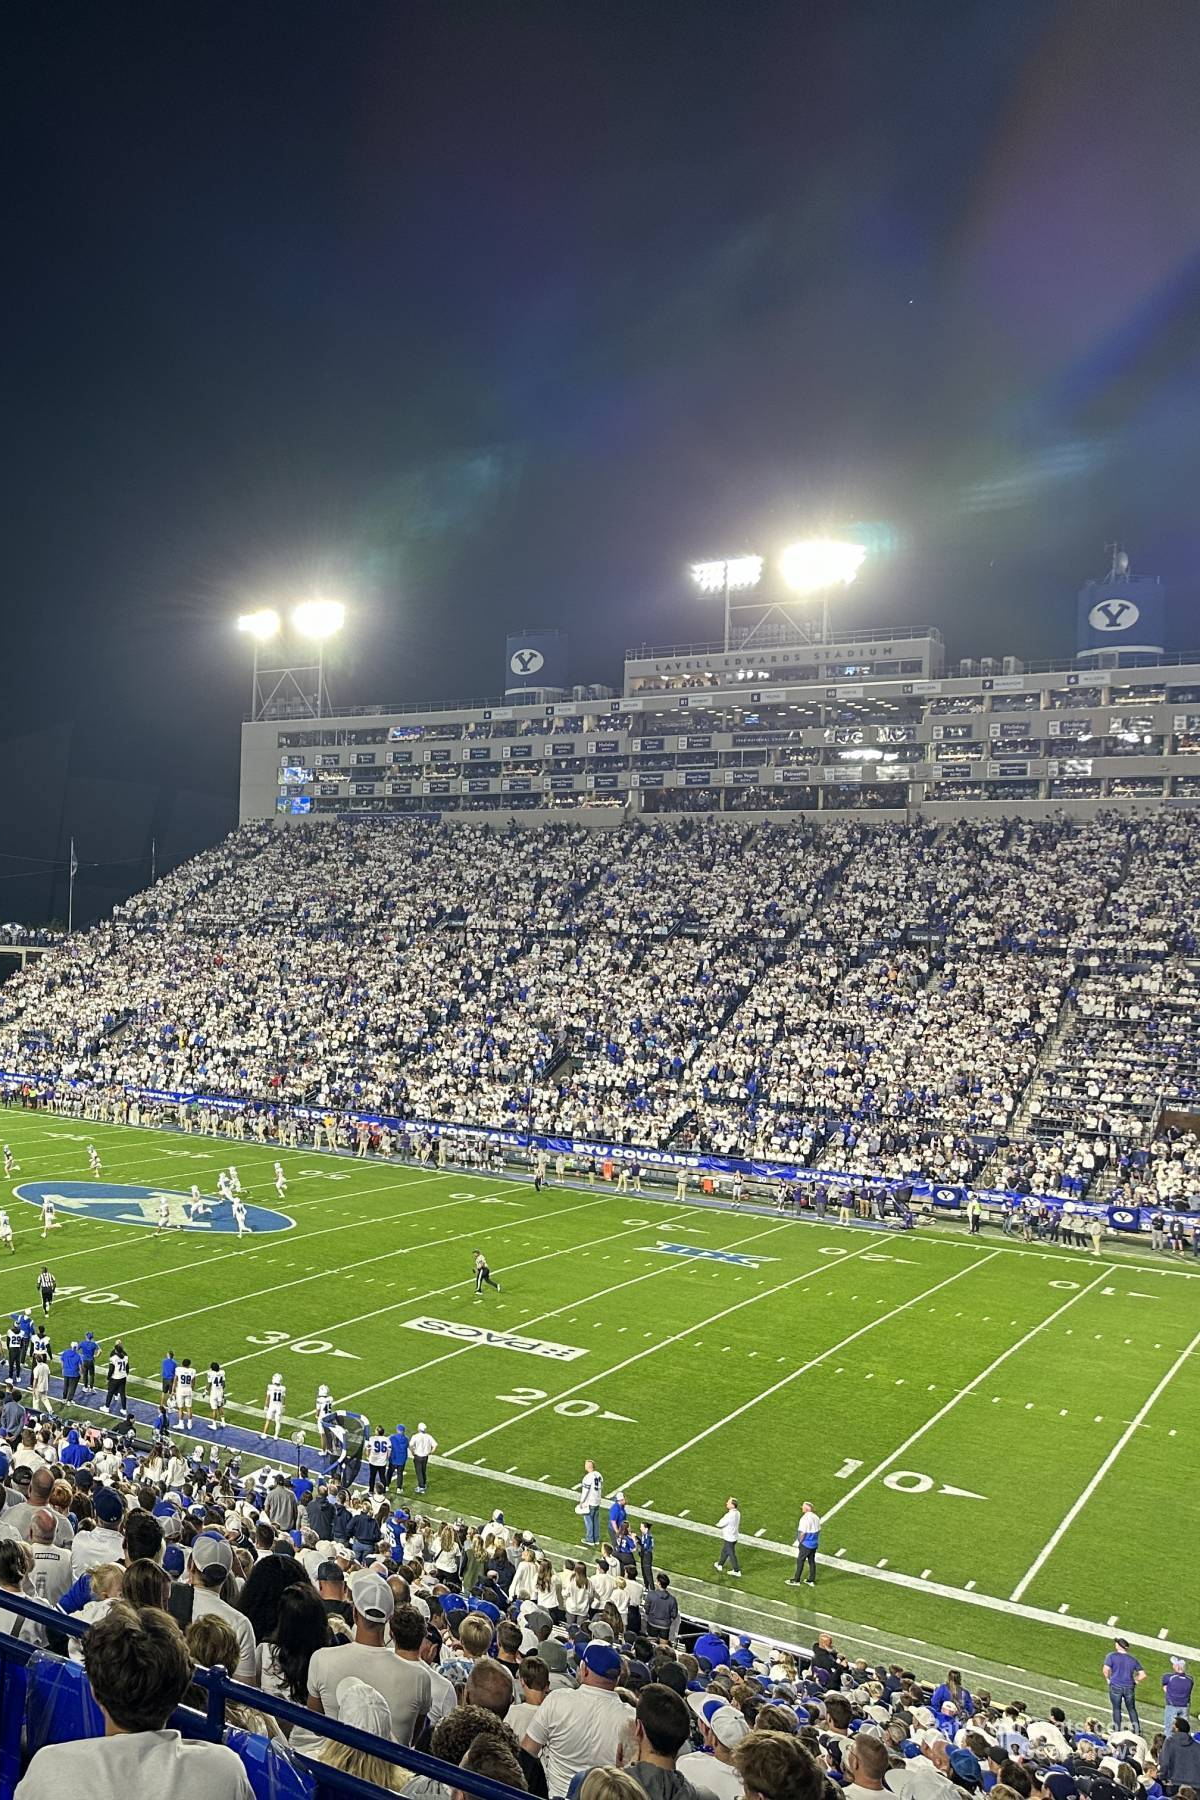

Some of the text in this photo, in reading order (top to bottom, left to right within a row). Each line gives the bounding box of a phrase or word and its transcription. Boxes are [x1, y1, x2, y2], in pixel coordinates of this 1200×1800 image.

[1097, 602, 1130, 627] Y
[512, 650, 541, 673] Y
[655, 647, 893, 672] LAVELL EDWARDS STADIUM
[572, 1143, 699, 1167] BYU COUGARS
[11, 1335, 22, 1344] 29
[34, 1341, 46, 1350] 34
[247, 1330, 333, 1354] 30
[417, 1320, 542, 1351] PACS
[117, 1360, 126, 1371] 71
[180, 1375, 192, 1385] 98
[213, 1377, 224, 1387] 44
[272, 1391, 283, 1401] 11
[496, 1387, 600, 1418] 20
[374, 1441, 387, 1452] 96
[834, 1457, 934, 1495] 10
